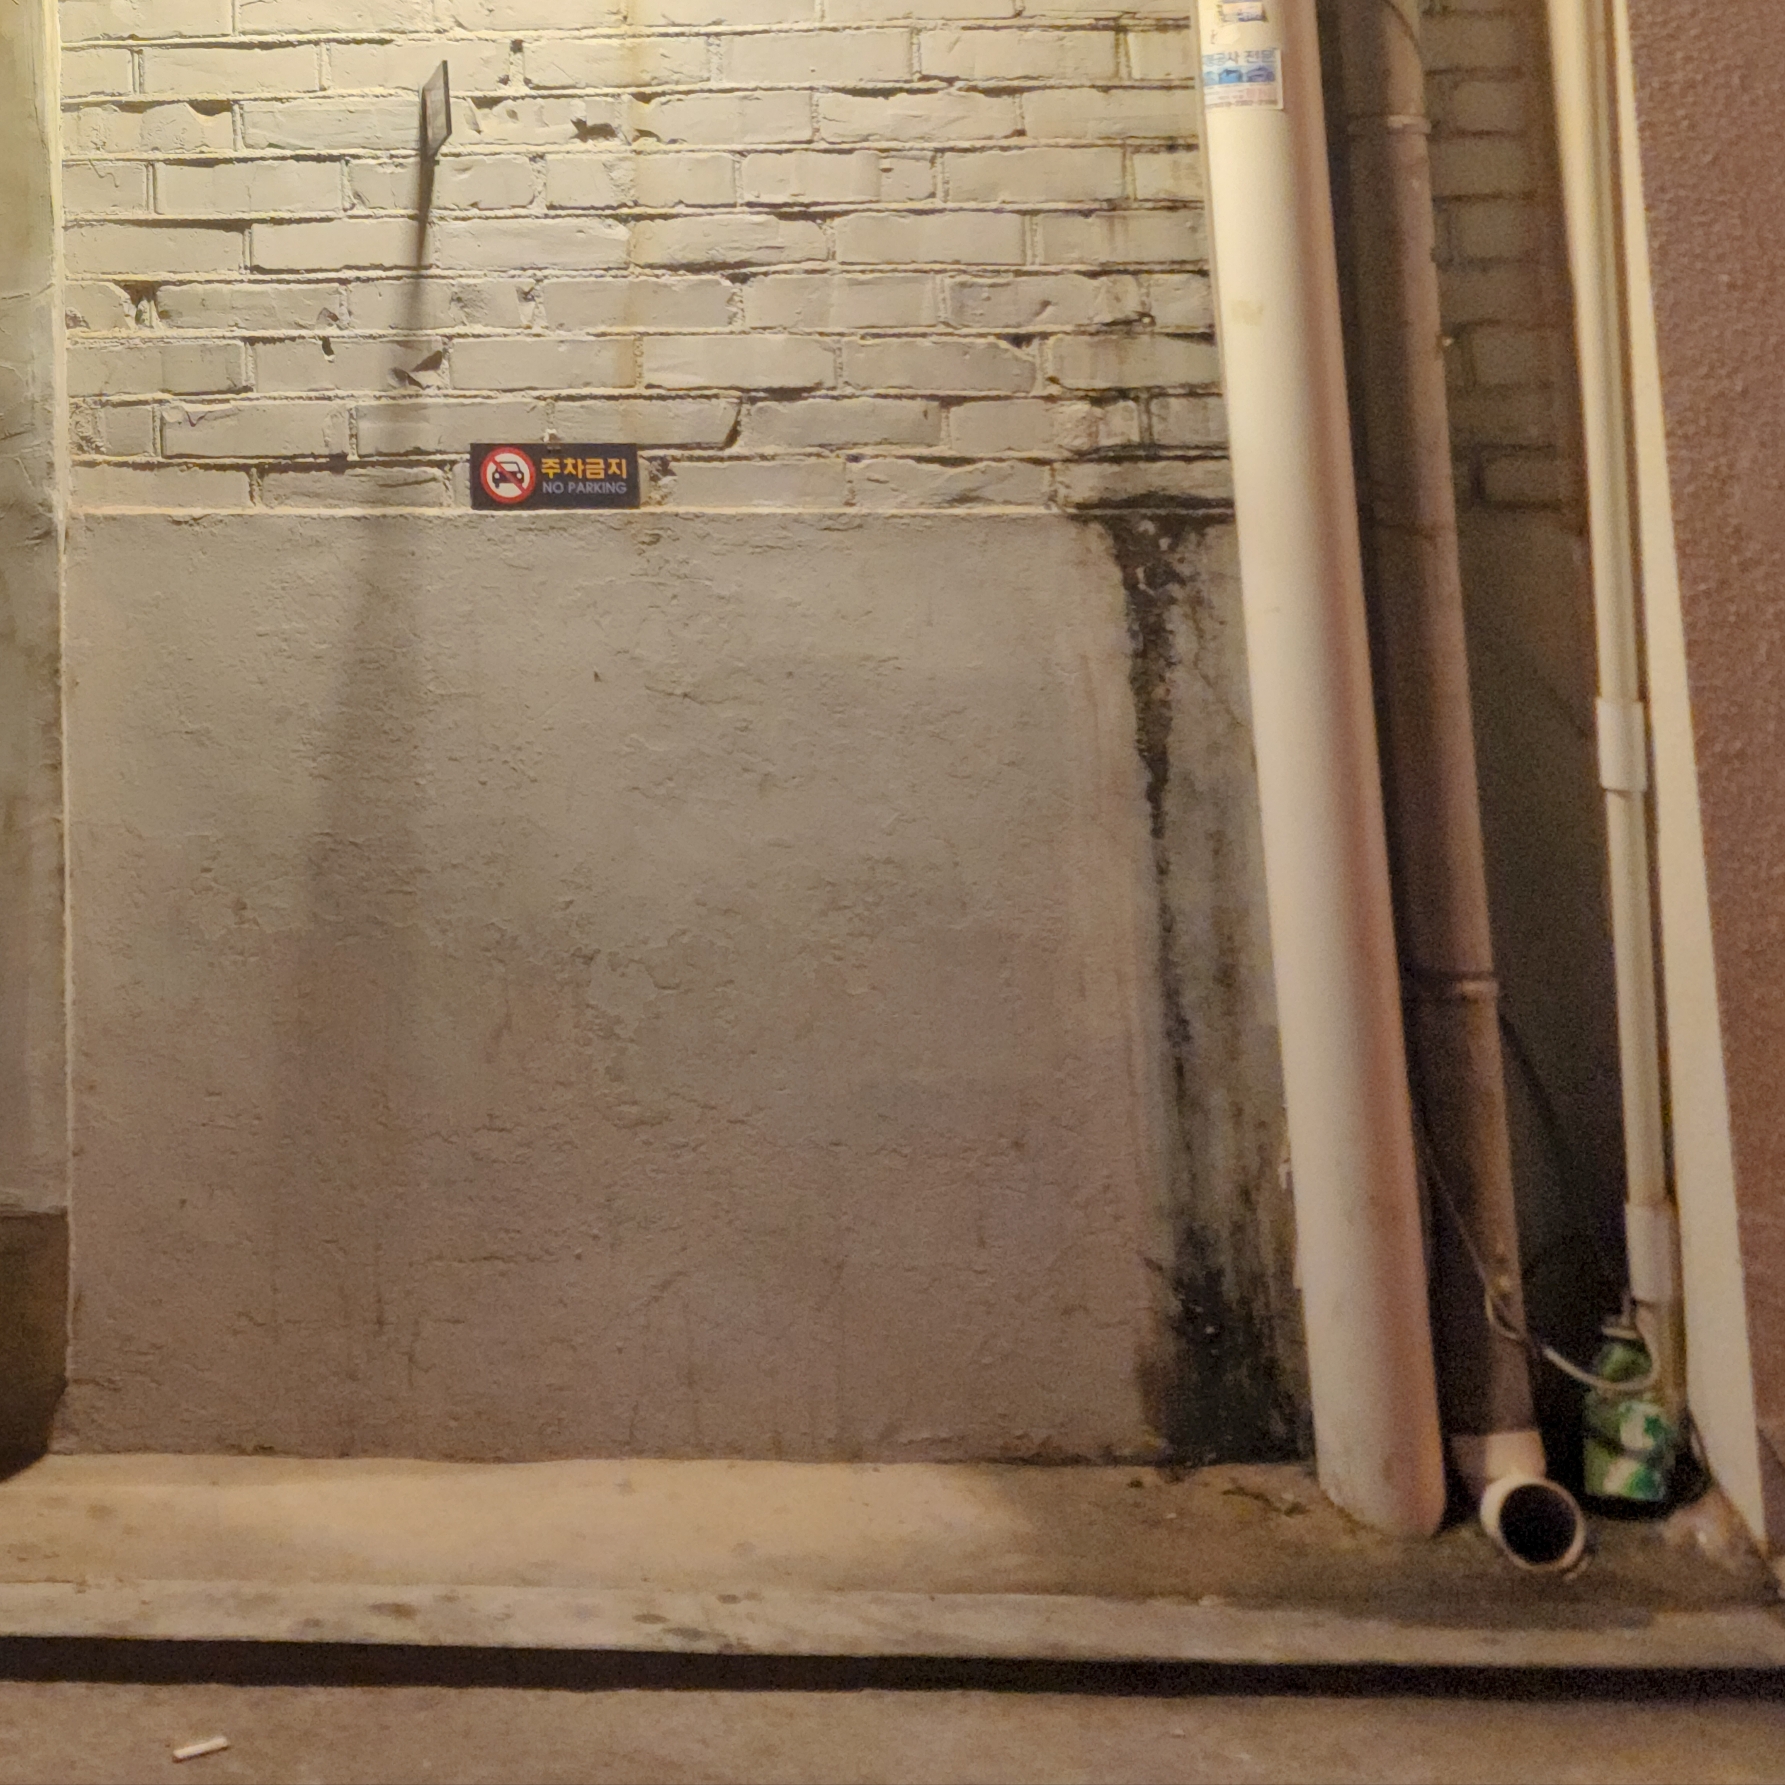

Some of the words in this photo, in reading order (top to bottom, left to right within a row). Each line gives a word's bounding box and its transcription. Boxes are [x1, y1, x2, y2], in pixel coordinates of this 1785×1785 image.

[541, 458, 627, 479] 주차금지
[543, 482, 564, 494] NO
[568, 482, 627, 494] PARKING
